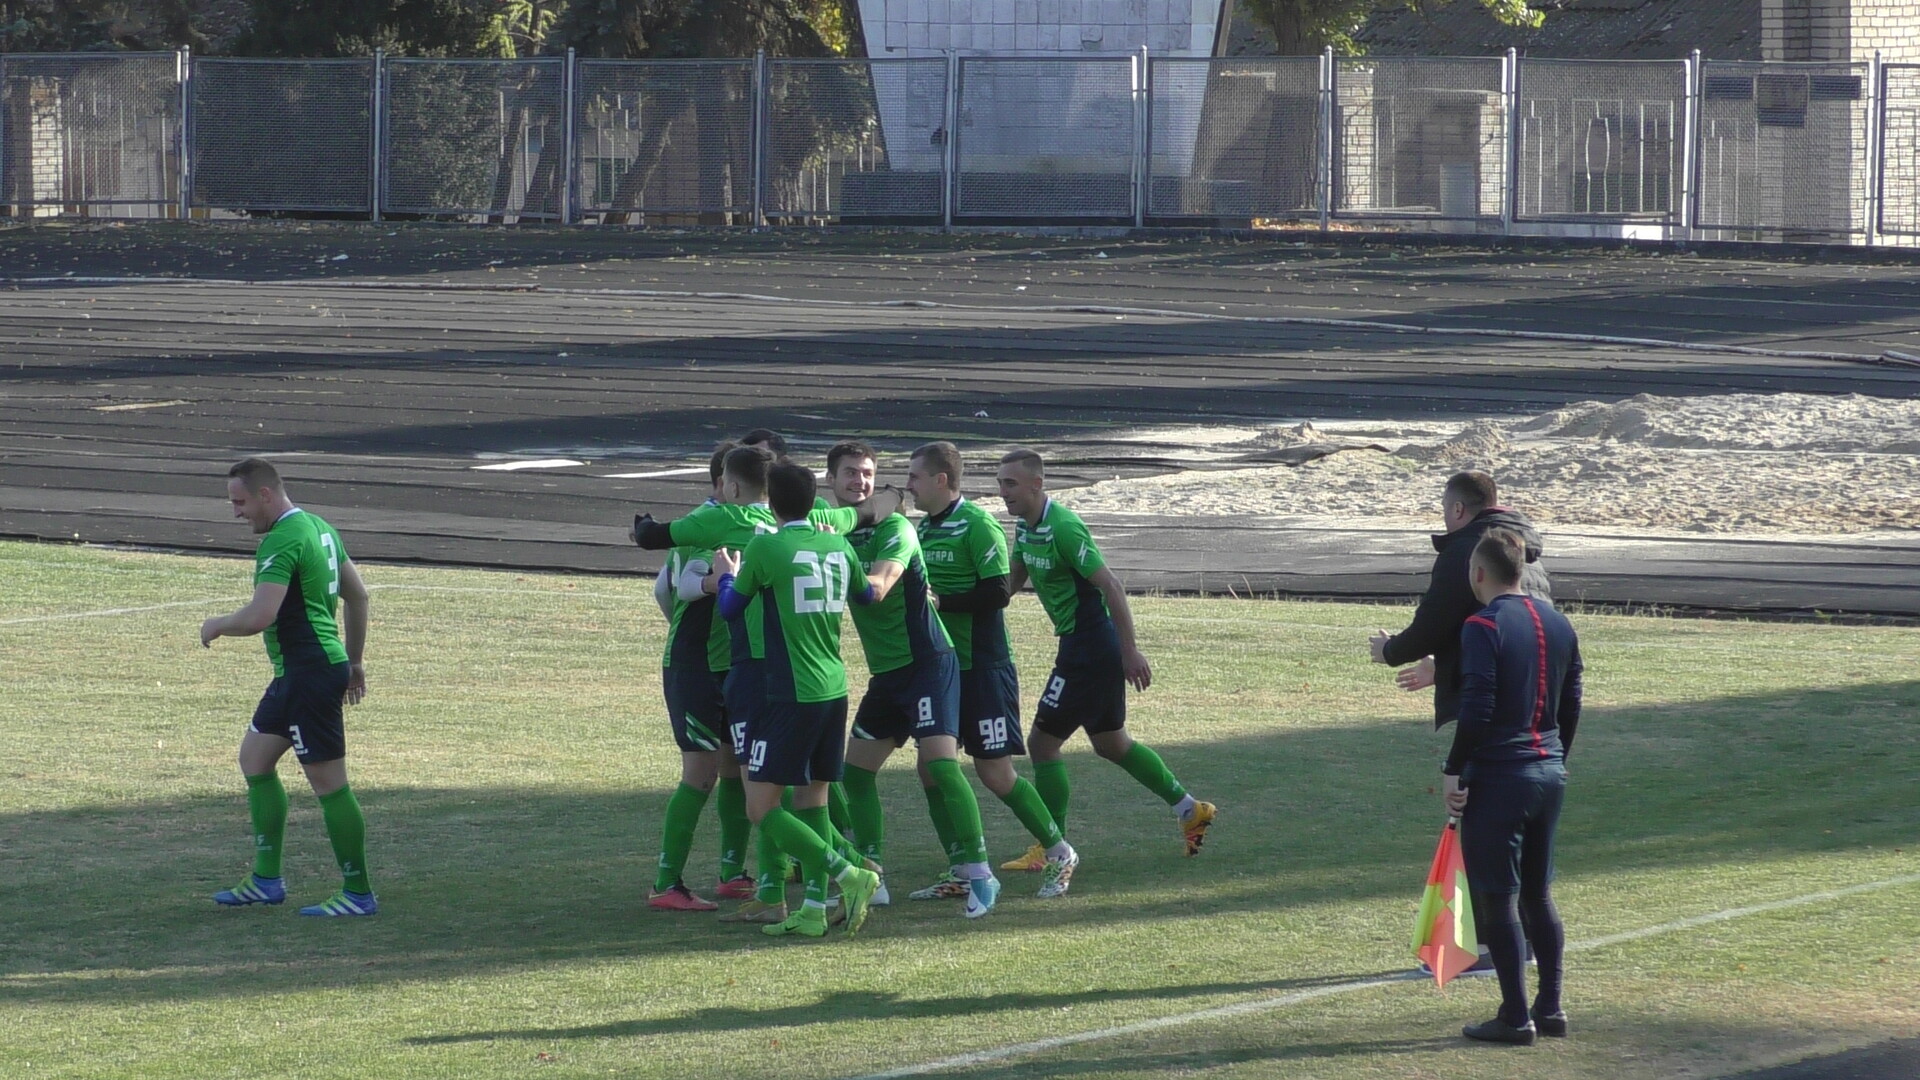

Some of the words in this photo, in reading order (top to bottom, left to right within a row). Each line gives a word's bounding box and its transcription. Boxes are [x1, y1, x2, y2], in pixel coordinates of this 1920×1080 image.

[321, 532, 339, 595] 3
[792, 550, 848, 614] 20
[1047, 675, 1066, 701] 9
[918, 696, 932, 721] 8
[289, 725, 304, 749] 3
[730, 721, 747, 748] 15
[979, 716, 1008, 744] 98
